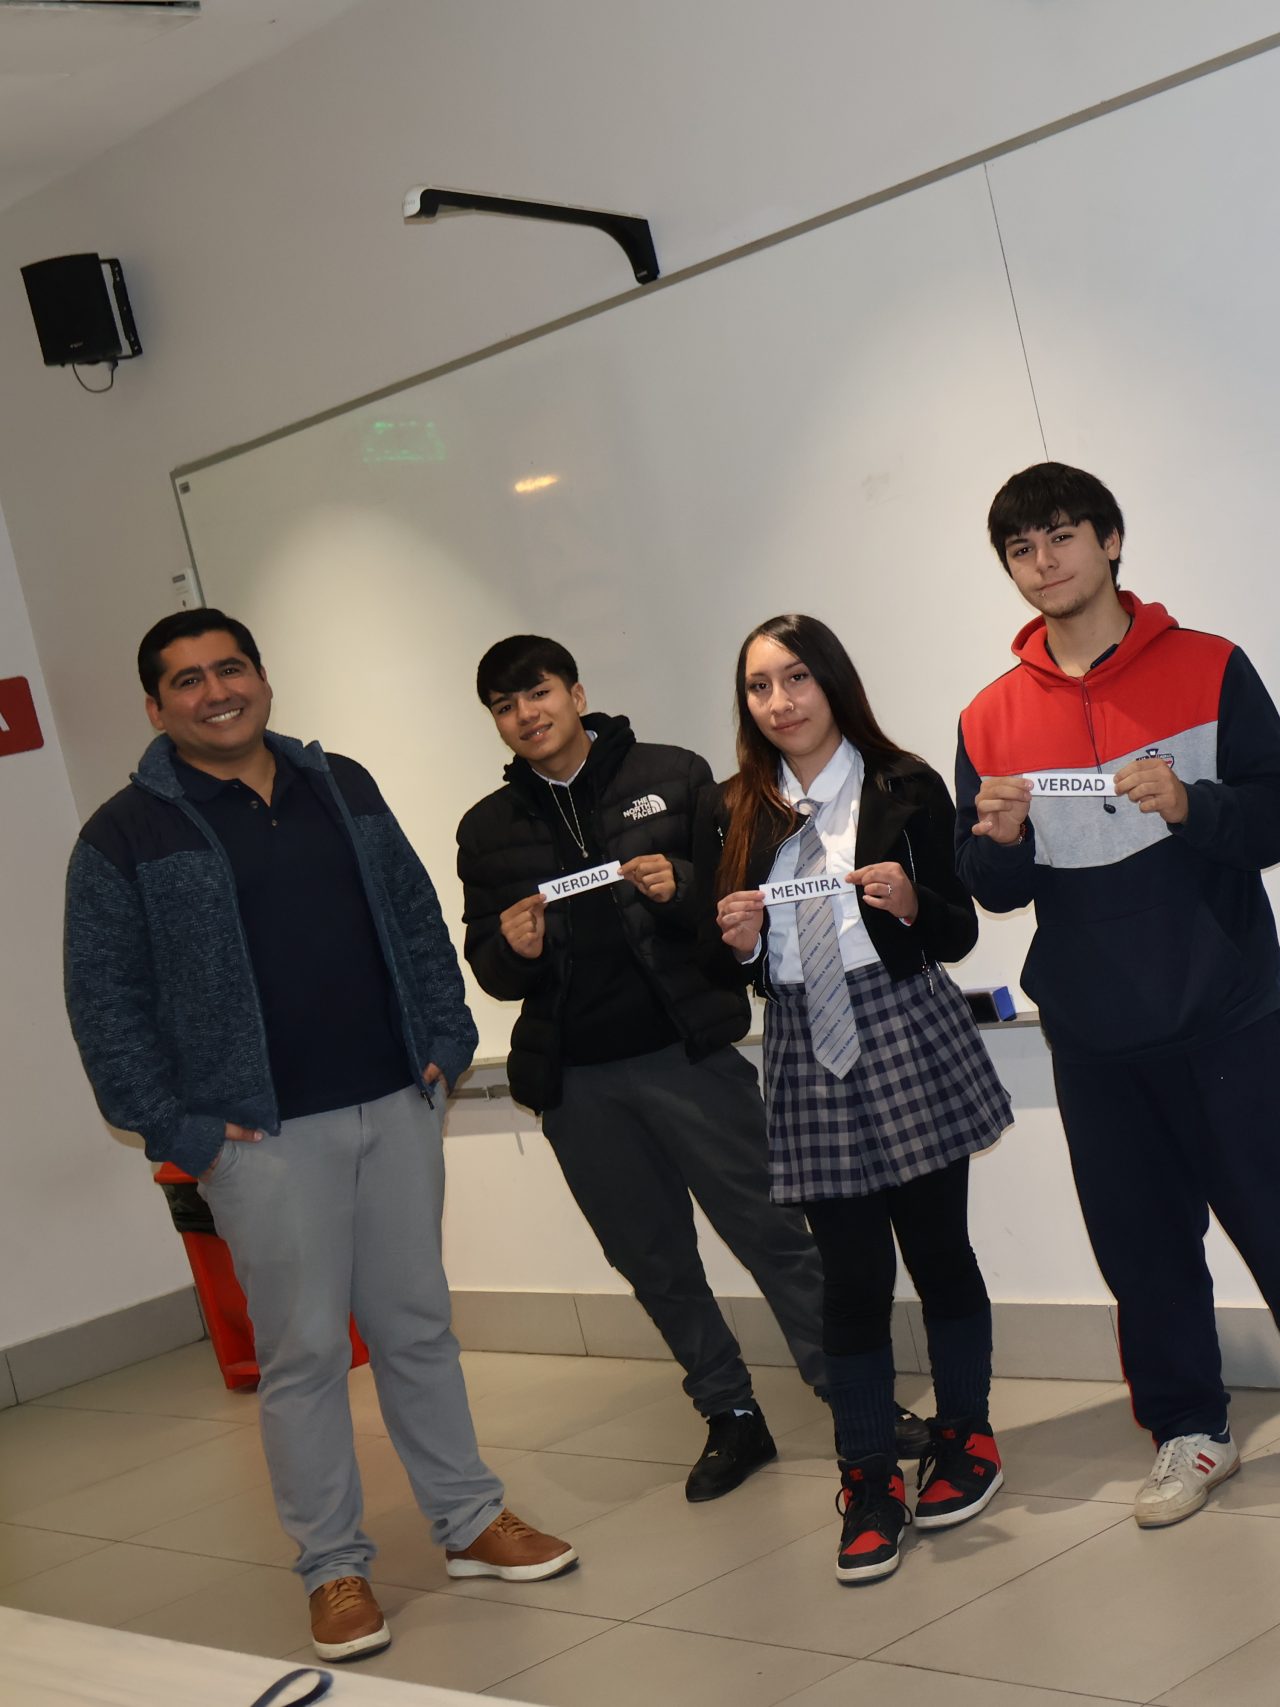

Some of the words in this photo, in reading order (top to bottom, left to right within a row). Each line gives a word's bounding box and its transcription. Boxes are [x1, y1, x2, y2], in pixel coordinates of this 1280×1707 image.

[1038, 778, 1105, 791] VERDAD
[632, 796, 649, 808] THE
[623, 803, 651, 818] NORTH
[633, 809, 653, 820] FACE
[551, 869, 609, 895] VERDAD
[771, 878, 841, 899] MENTIRA
